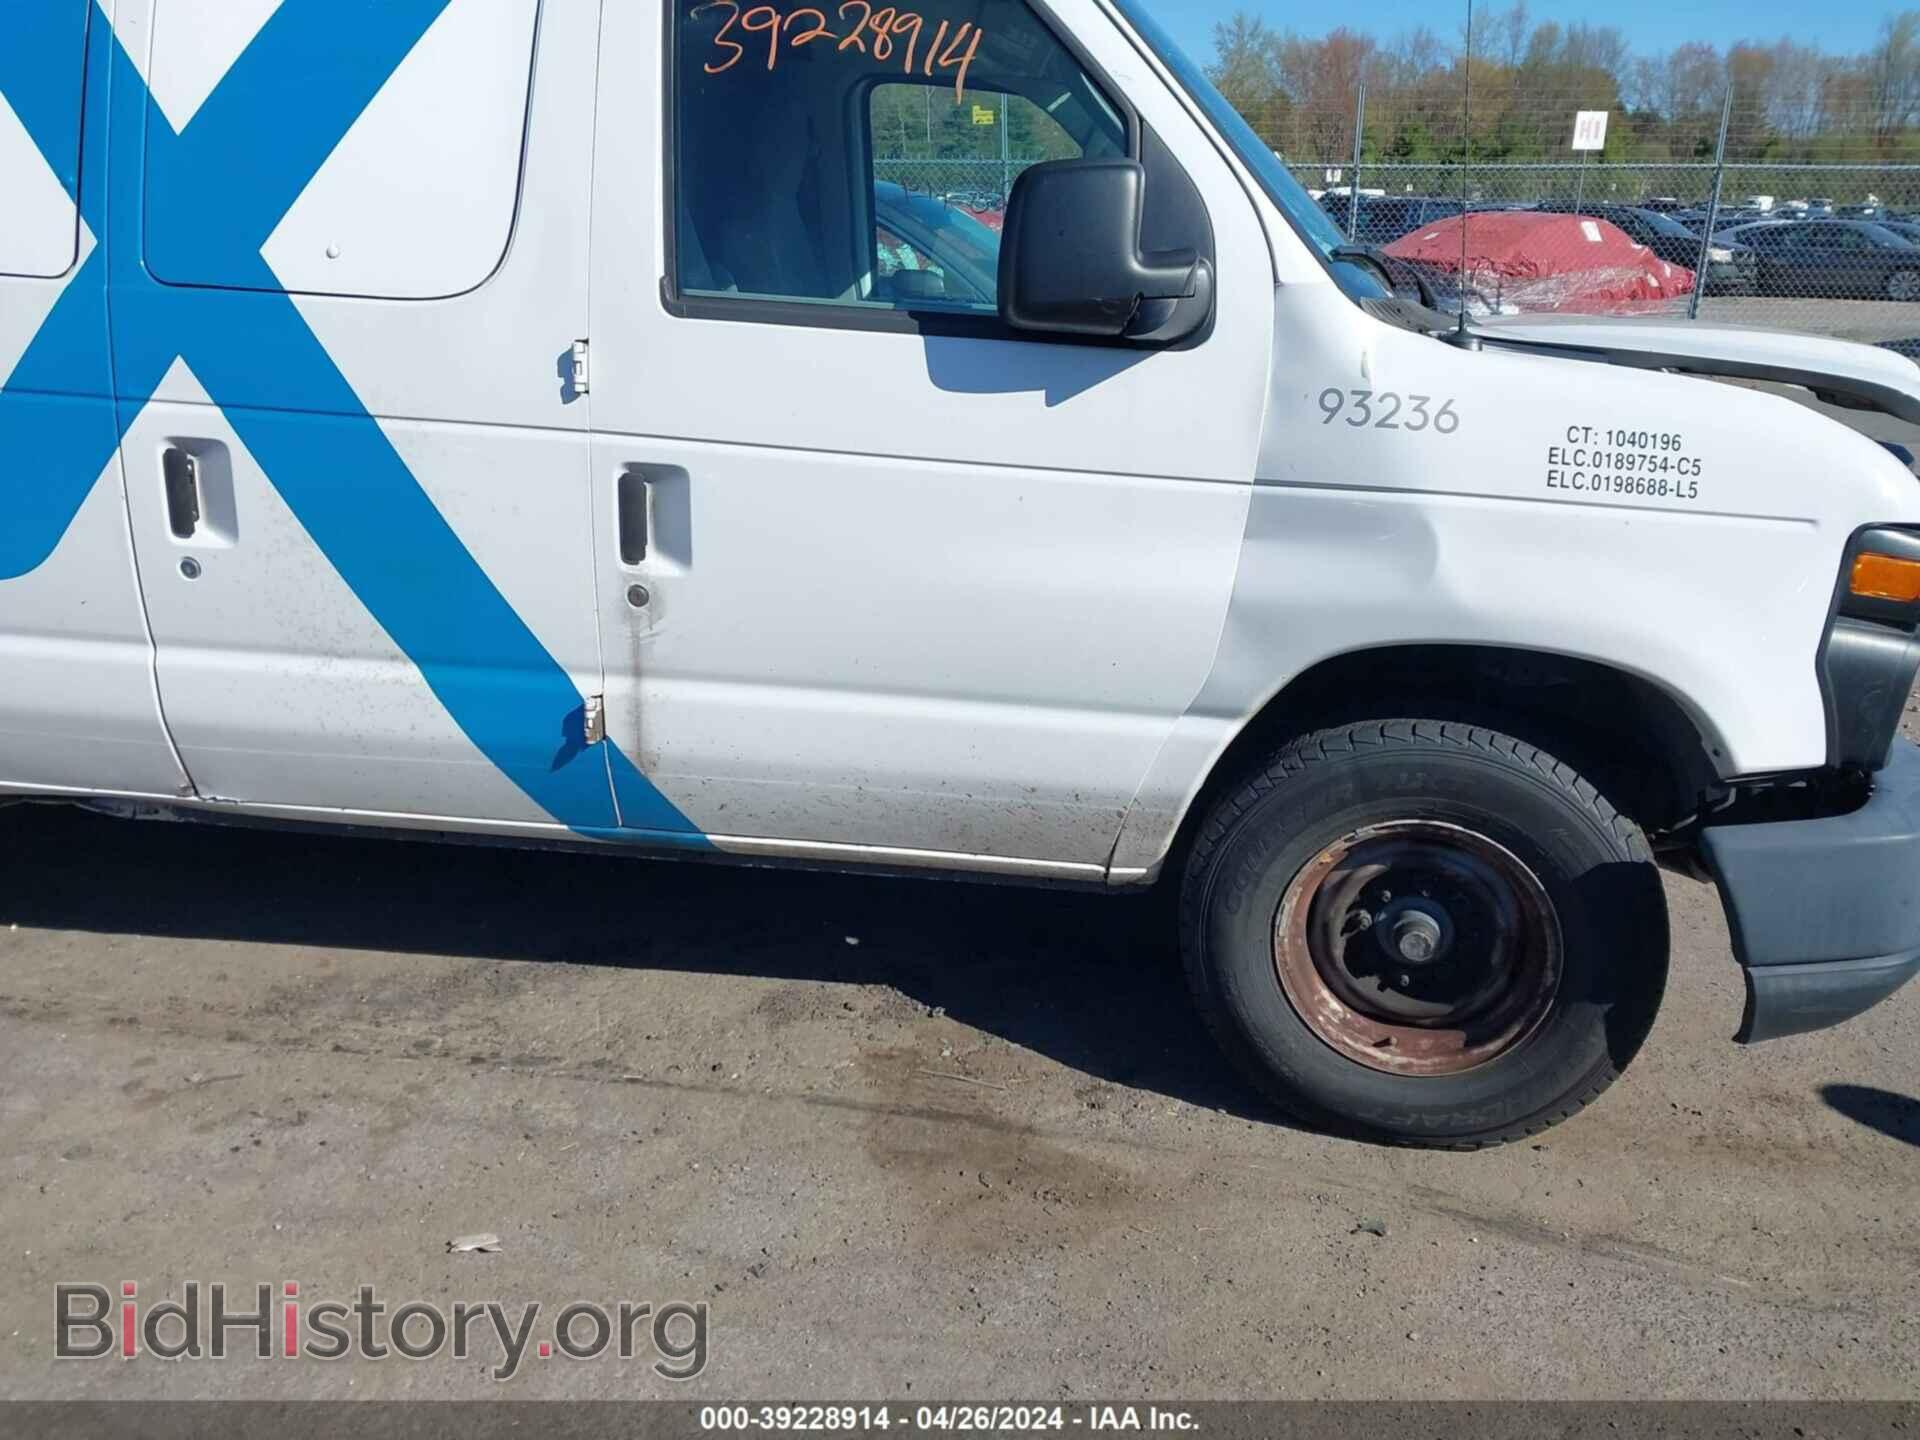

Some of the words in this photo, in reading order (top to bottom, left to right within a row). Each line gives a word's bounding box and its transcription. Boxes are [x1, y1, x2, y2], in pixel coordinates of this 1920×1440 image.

[690, 0, 983, 105] 39228914
[1319, 387, 1460, 434] 93236
[1566, 426, 1599, 446] CT:
[1605, 429, 1682, 452] 1040196
[1548, 447, 1702, 476] ELC.0189754-C5
[1546, 470, 1699, 499] ELC.0198688-L5
